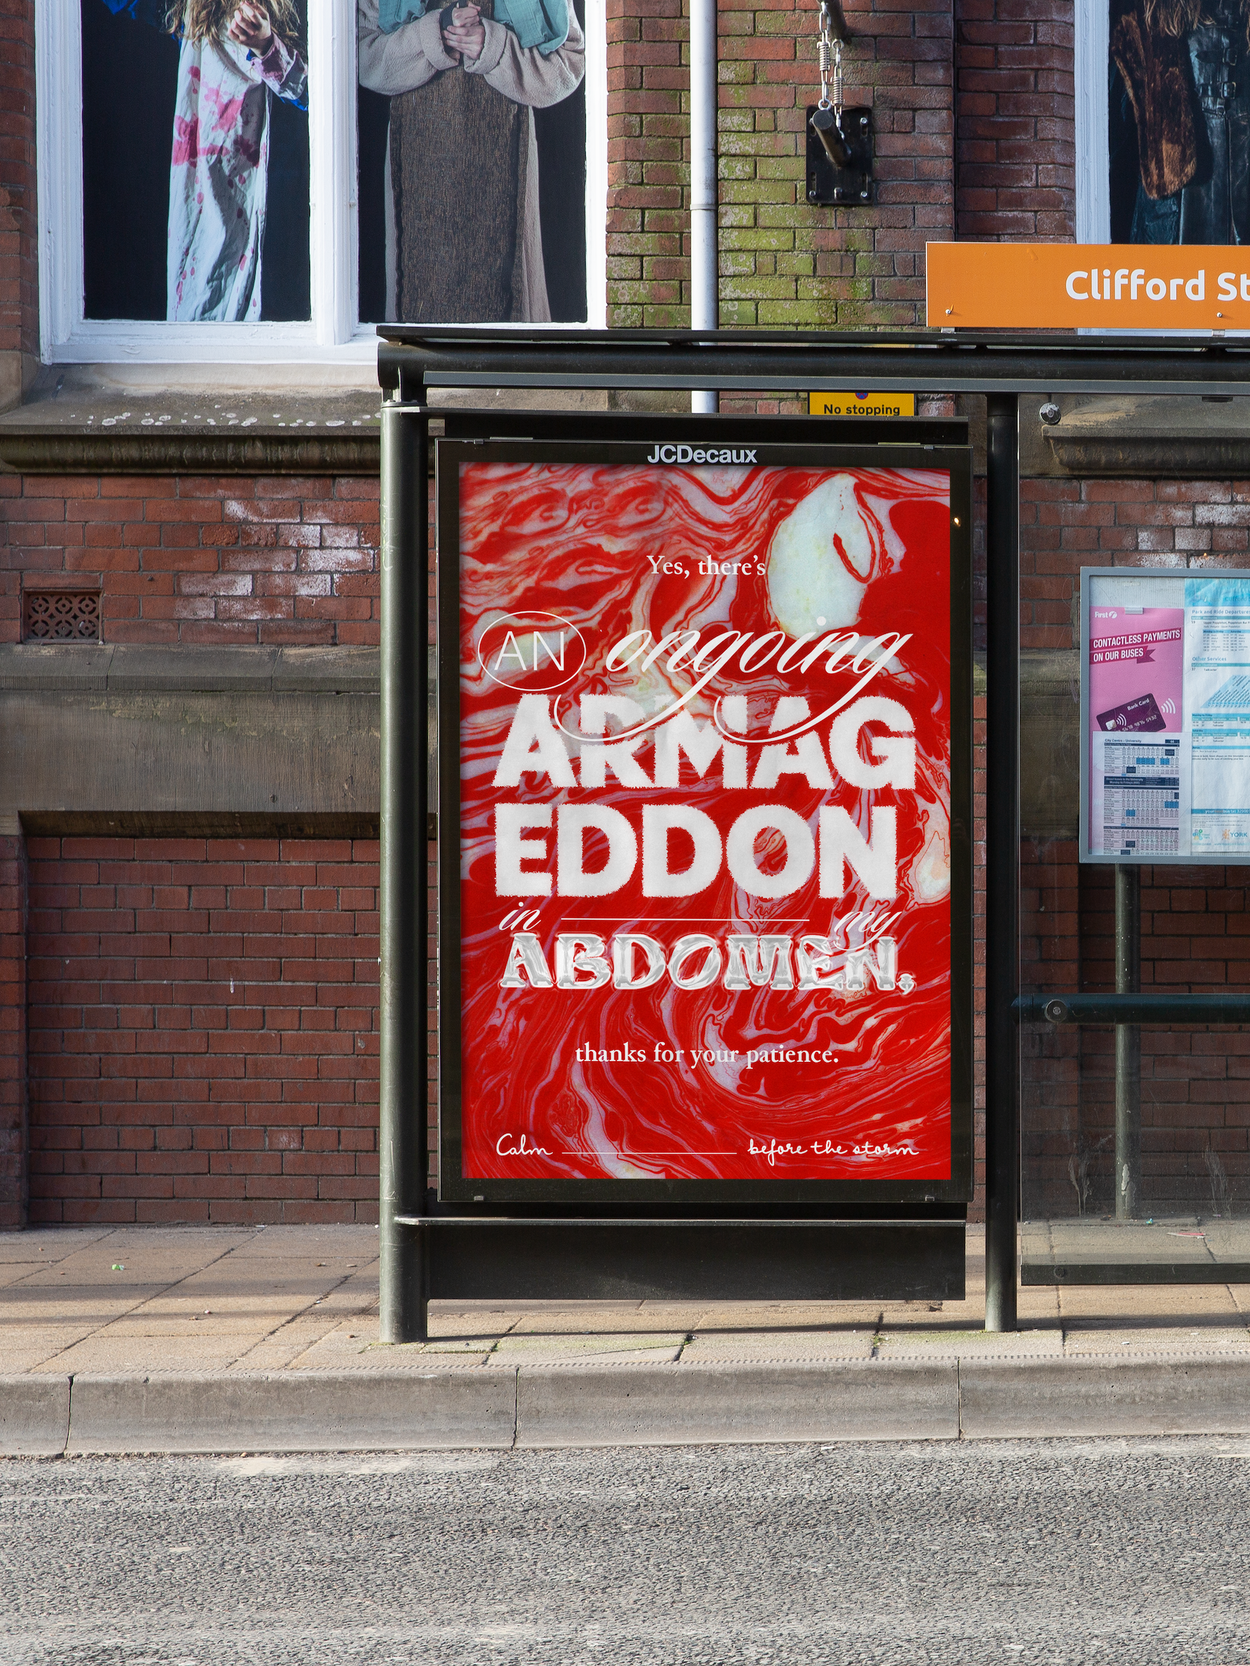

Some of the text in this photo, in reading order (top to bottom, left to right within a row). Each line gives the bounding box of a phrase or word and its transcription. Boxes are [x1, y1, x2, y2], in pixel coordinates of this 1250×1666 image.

[1065, 268, 1204, 302] Clifford
[823, 404, 900, 416] No stopping
[647, 445, 758, 464] JCDecaux
[647, 554, 766, 579] Yes, there’s
[494, 629, 566, 672] AN
[1093, 629, 1181, 648] CONTACTLESS PAYMENTS
[1093, 648, 1144, 662] ON OUR BUSES
[553, 616, 913, 744] ongoing
[1127, 698, 1150, 711] Bank Card
[491, 693, 916, 790] ARMAG
[494, 802, 898, 900] EDDON
[498, 902, 903, 951] in my
[575, 1041, 840, 1070] thanks for your patience.
[496, 1133, 553, 1157] Calm
[747, 1138, 920, 1167] before the storm
